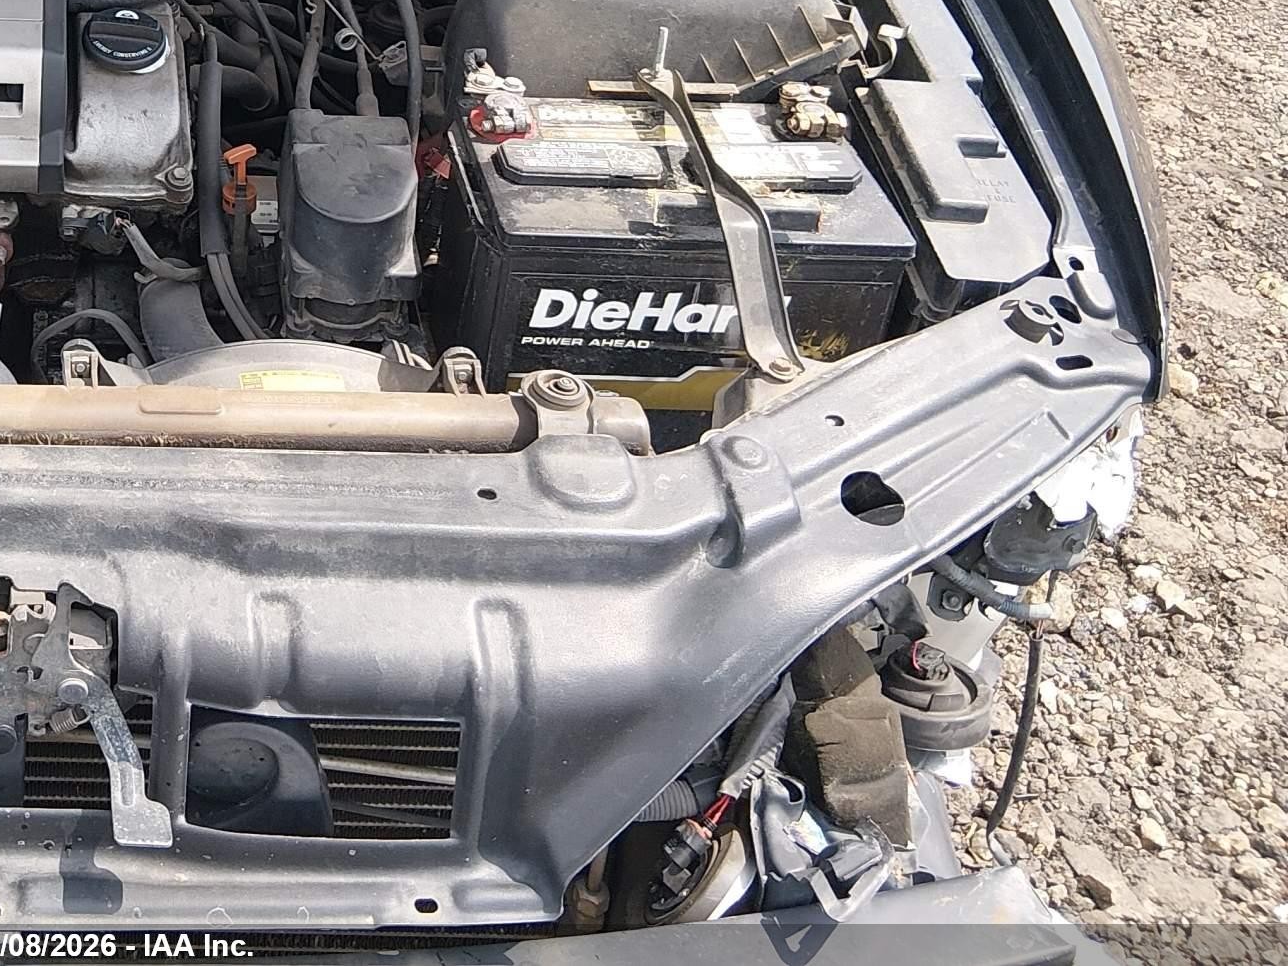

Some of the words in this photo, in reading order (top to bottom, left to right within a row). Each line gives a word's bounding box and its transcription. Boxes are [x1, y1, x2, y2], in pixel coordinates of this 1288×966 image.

[528, 287, 792, 334] DieHar
[520, 336, 584, 347] POWER
[588, 337, 652, 349] AHEAD
